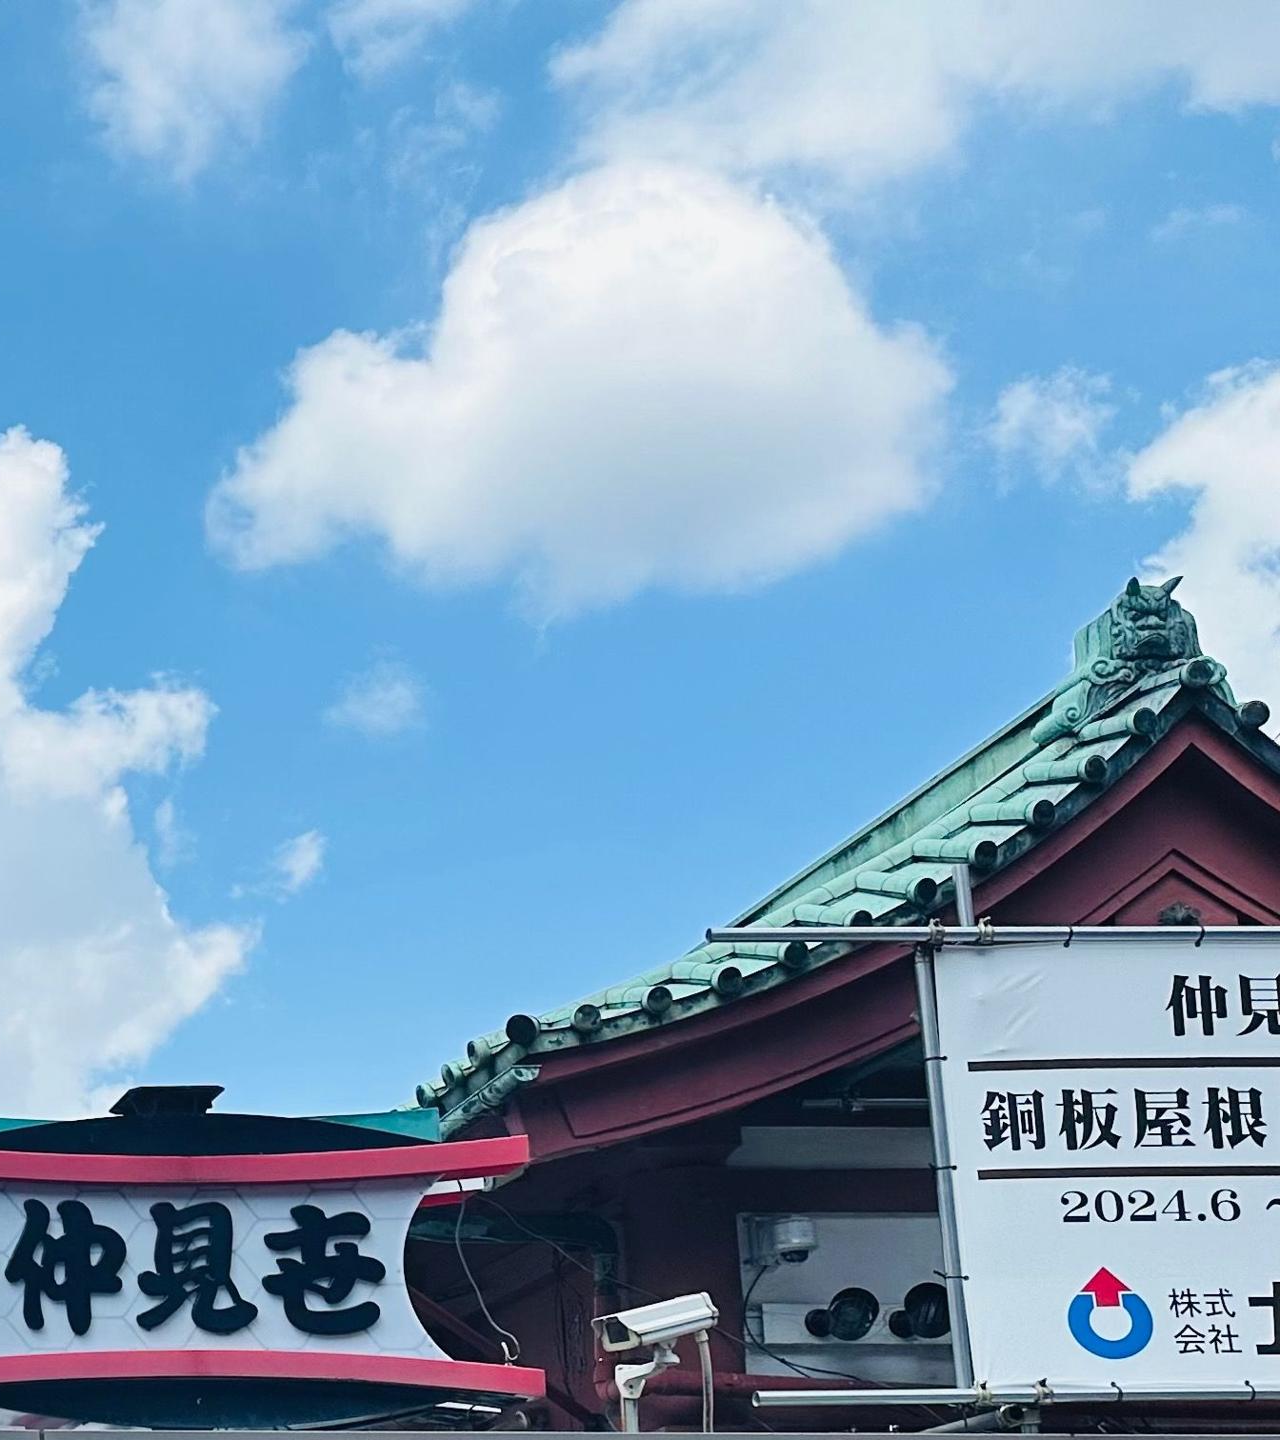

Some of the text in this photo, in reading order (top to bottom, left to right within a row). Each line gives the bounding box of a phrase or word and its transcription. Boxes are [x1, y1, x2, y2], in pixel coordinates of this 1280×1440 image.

[980, 1086, 1268, 1151] 銅板屋根
[1060, 1189, 1241, 1223] 2024.6
[4, 1198, 386, 1336] 仲見世
[1168, 1288, 1236, 1318] 株式
[1173, 1324, 1243, 1354] 会社
